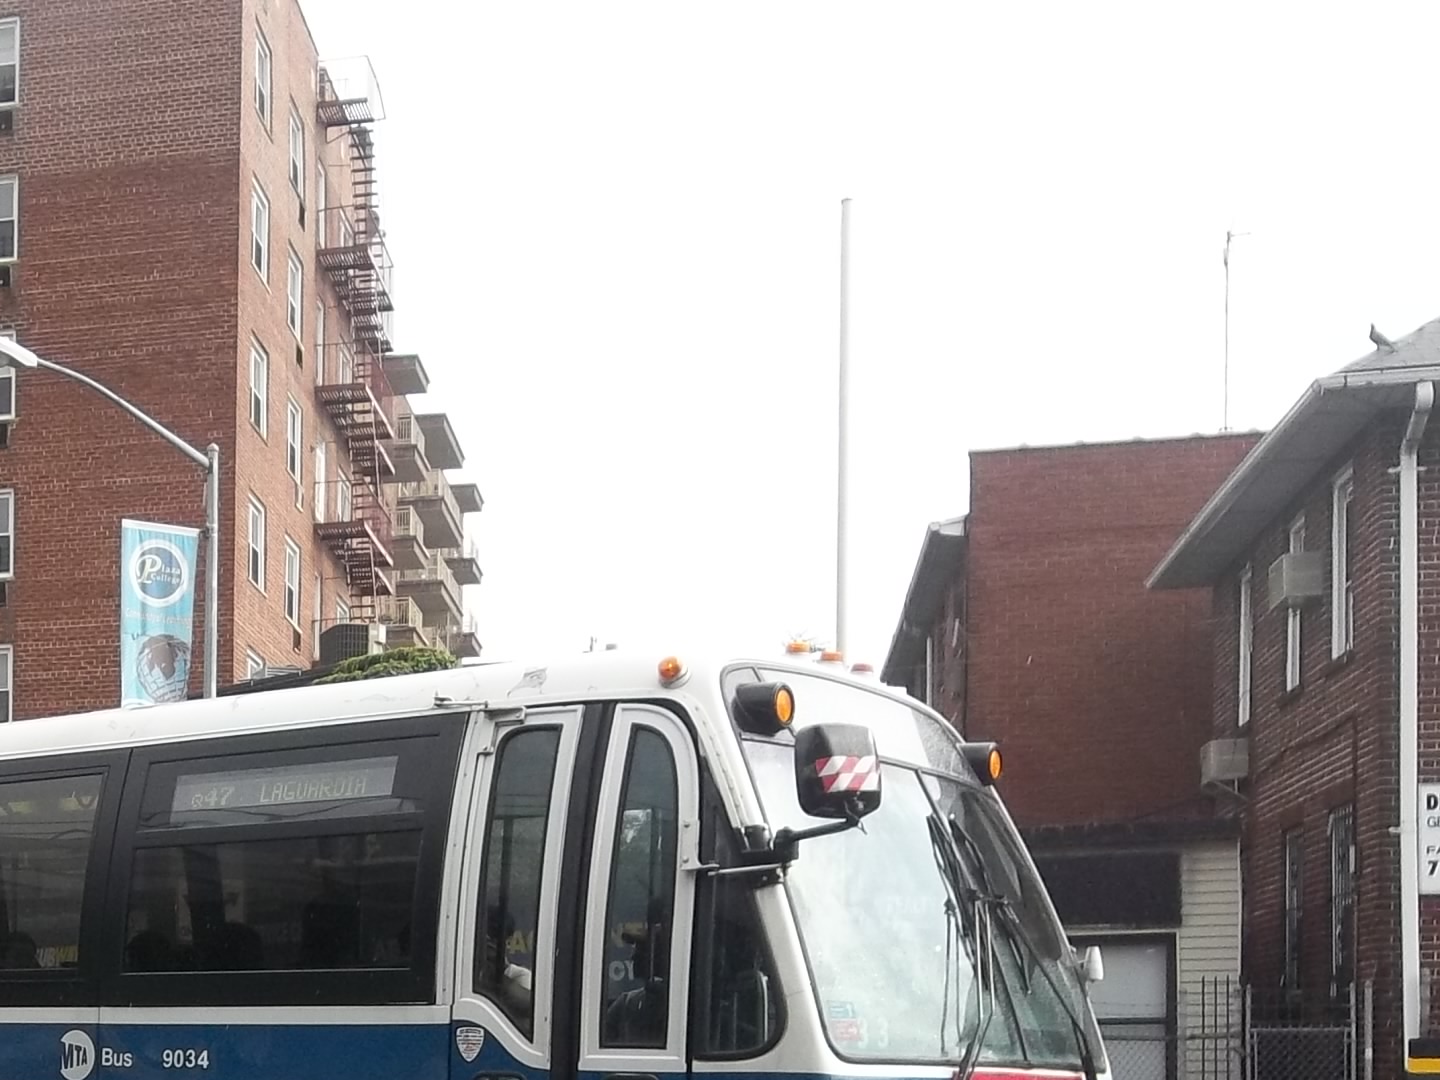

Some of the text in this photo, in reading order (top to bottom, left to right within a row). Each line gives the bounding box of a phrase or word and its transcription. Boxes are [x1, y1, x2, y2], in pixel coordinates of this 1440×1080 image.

[135, 554, 181, 584] Plaza
[191, 786, 235, 808] Q47
[101, 1047, 133, 1068] Bus
[162, 1049, 210, 1069] 9034
